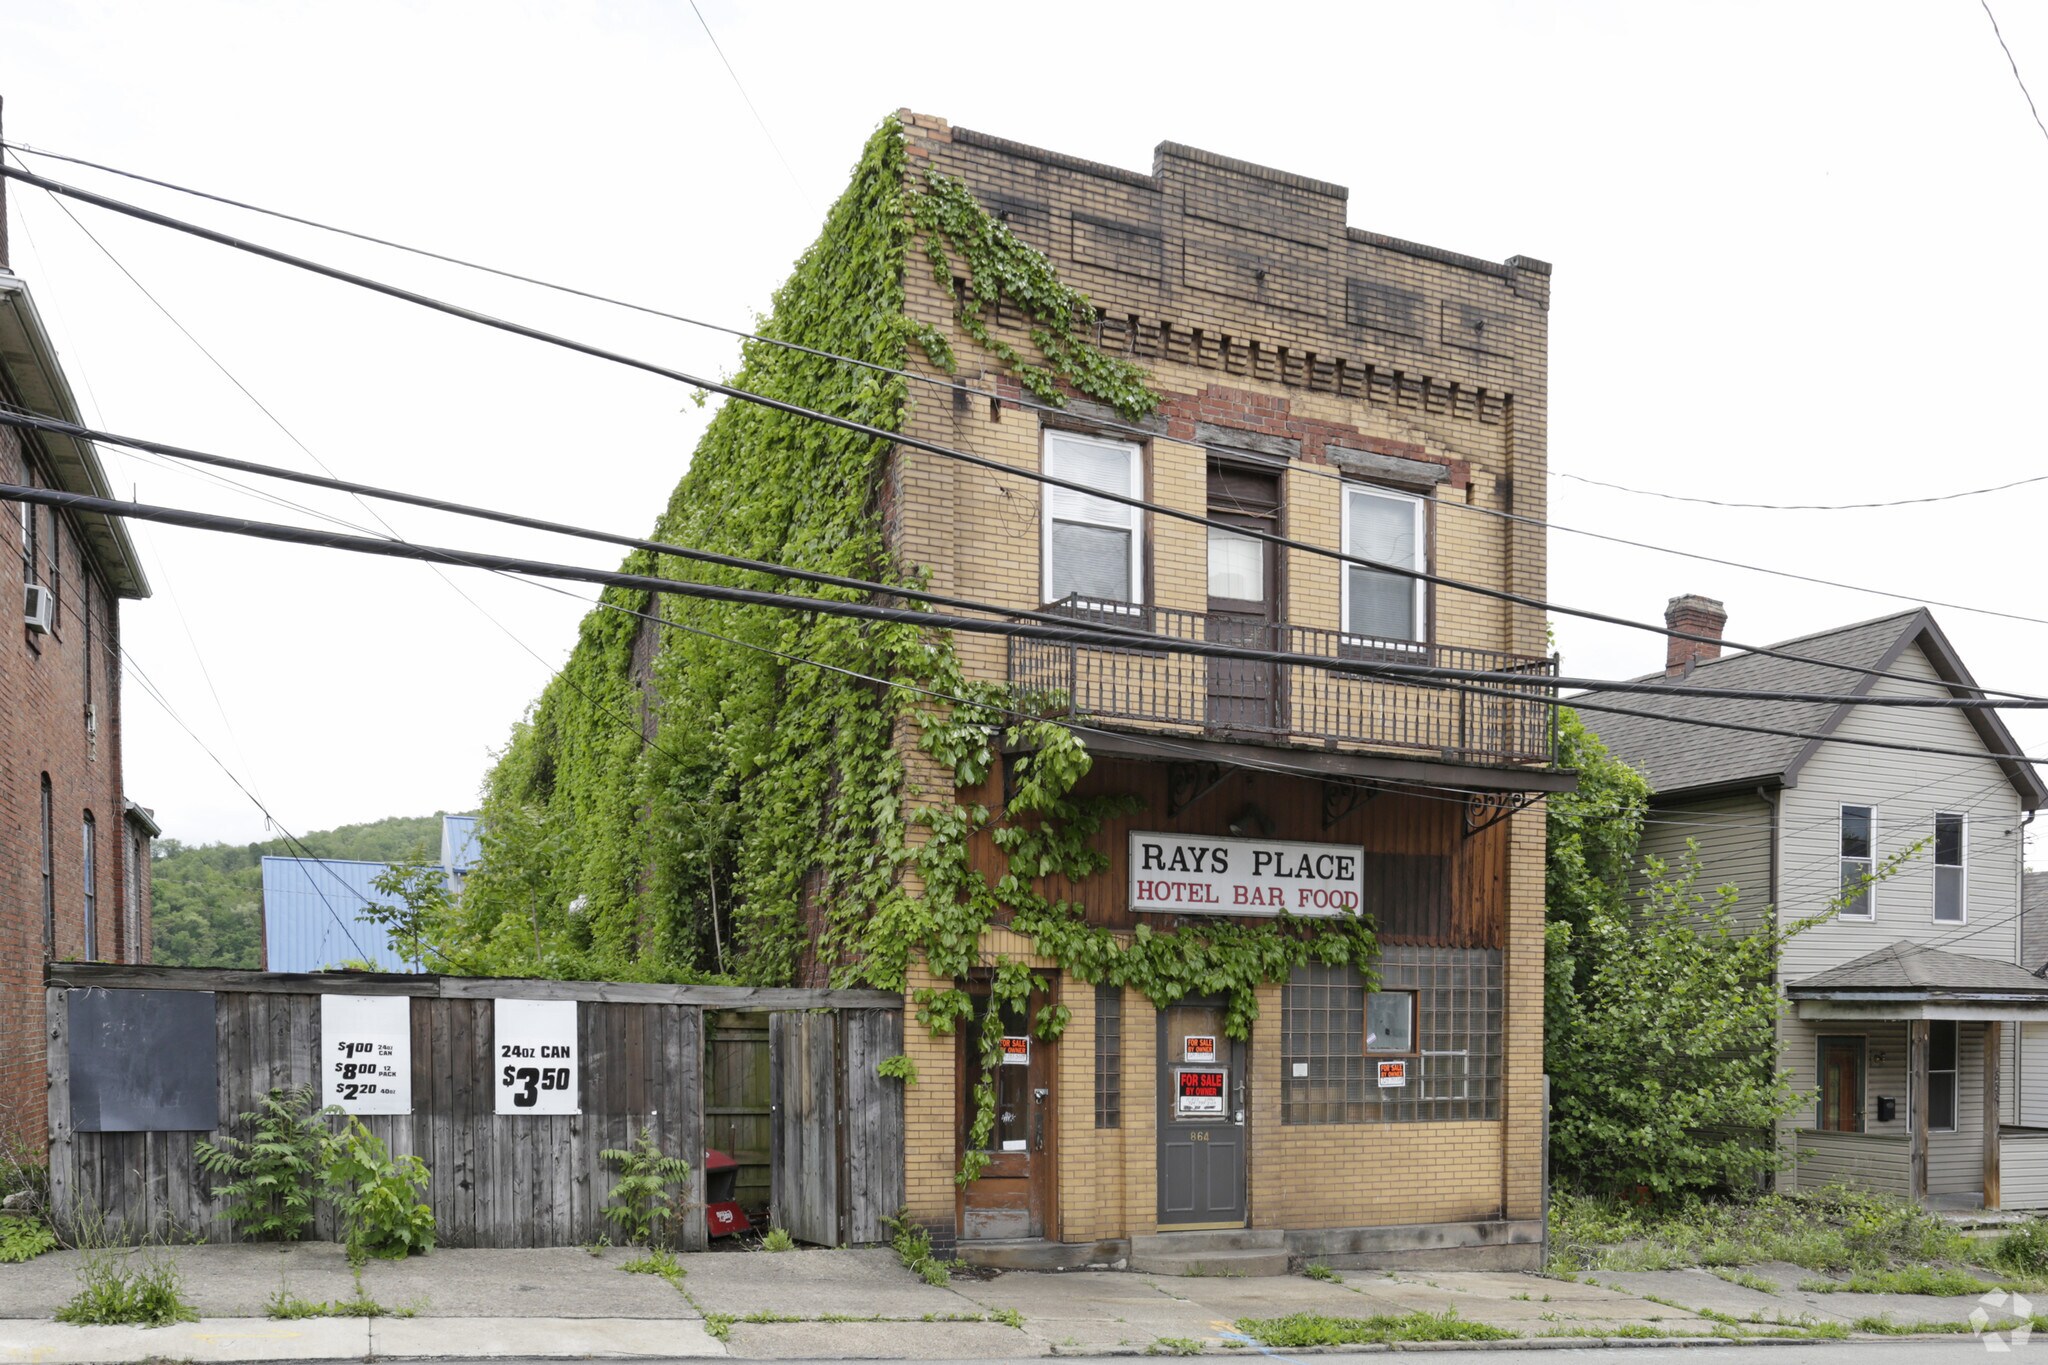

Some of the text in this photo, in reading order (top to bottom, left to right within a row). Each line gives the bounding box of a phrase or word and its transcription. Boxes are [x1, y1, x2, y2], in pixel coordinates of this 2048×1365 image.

[1141, 843, 1355, 881] RAYS PLACE
[1136, 880, 1359, 910] HOTEL BAR FOOD
[1012, 1040, 1026, 1048] SALE
[541, 1045, 571, 1059] CAN
[1181, 1073, 1222, 1087] FOR SALE
[1185, 1087, 1217, 1096] BY OWNER
[1190, 1131, 1210, 1142] 864
